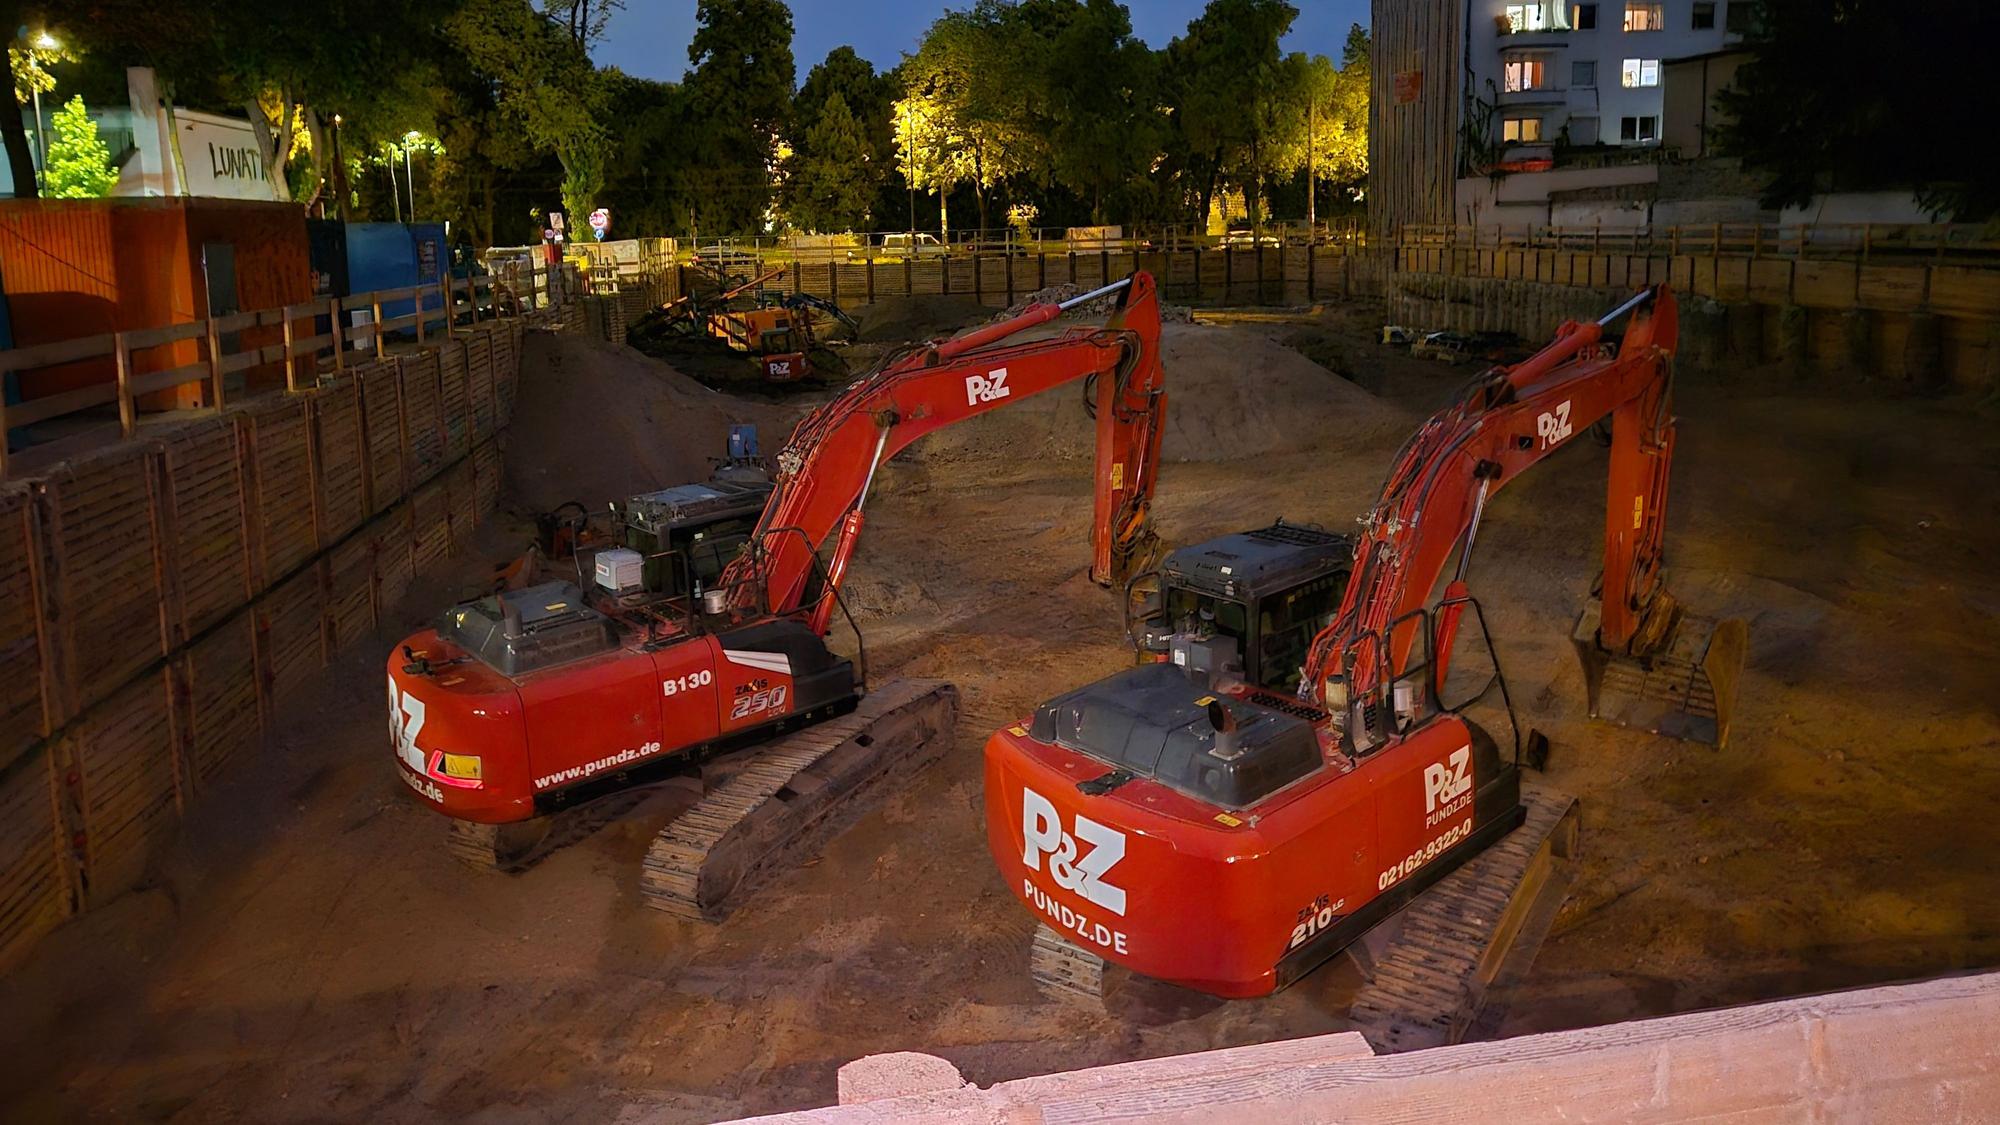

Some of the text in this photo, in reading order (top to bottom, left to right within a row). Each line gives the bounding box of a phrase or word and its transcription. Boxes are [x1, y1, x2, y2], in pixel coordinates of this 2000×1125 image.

[965, 367, 1010, 406] P&Z
[1537, 399, 1572, 450] P&Z
[662, 669, 712, 697] B130
[730, 685, 787, 720] 250
[735, 678, 768, 695] ZAXIS
[534, 741, 661, 789] www.pundz.de
[1423, 744, 1472, 815] P&Z
[1425, 791, 1473, 830] PUNDZ.DE
[1022, 786, 1127, 917] P&Z
[1378, 817, 1472, 891] 02162-9322-0
[1023, 878, 1129, 956] PUNDZ.DE
[1290, 907, 1332, 949] 210
